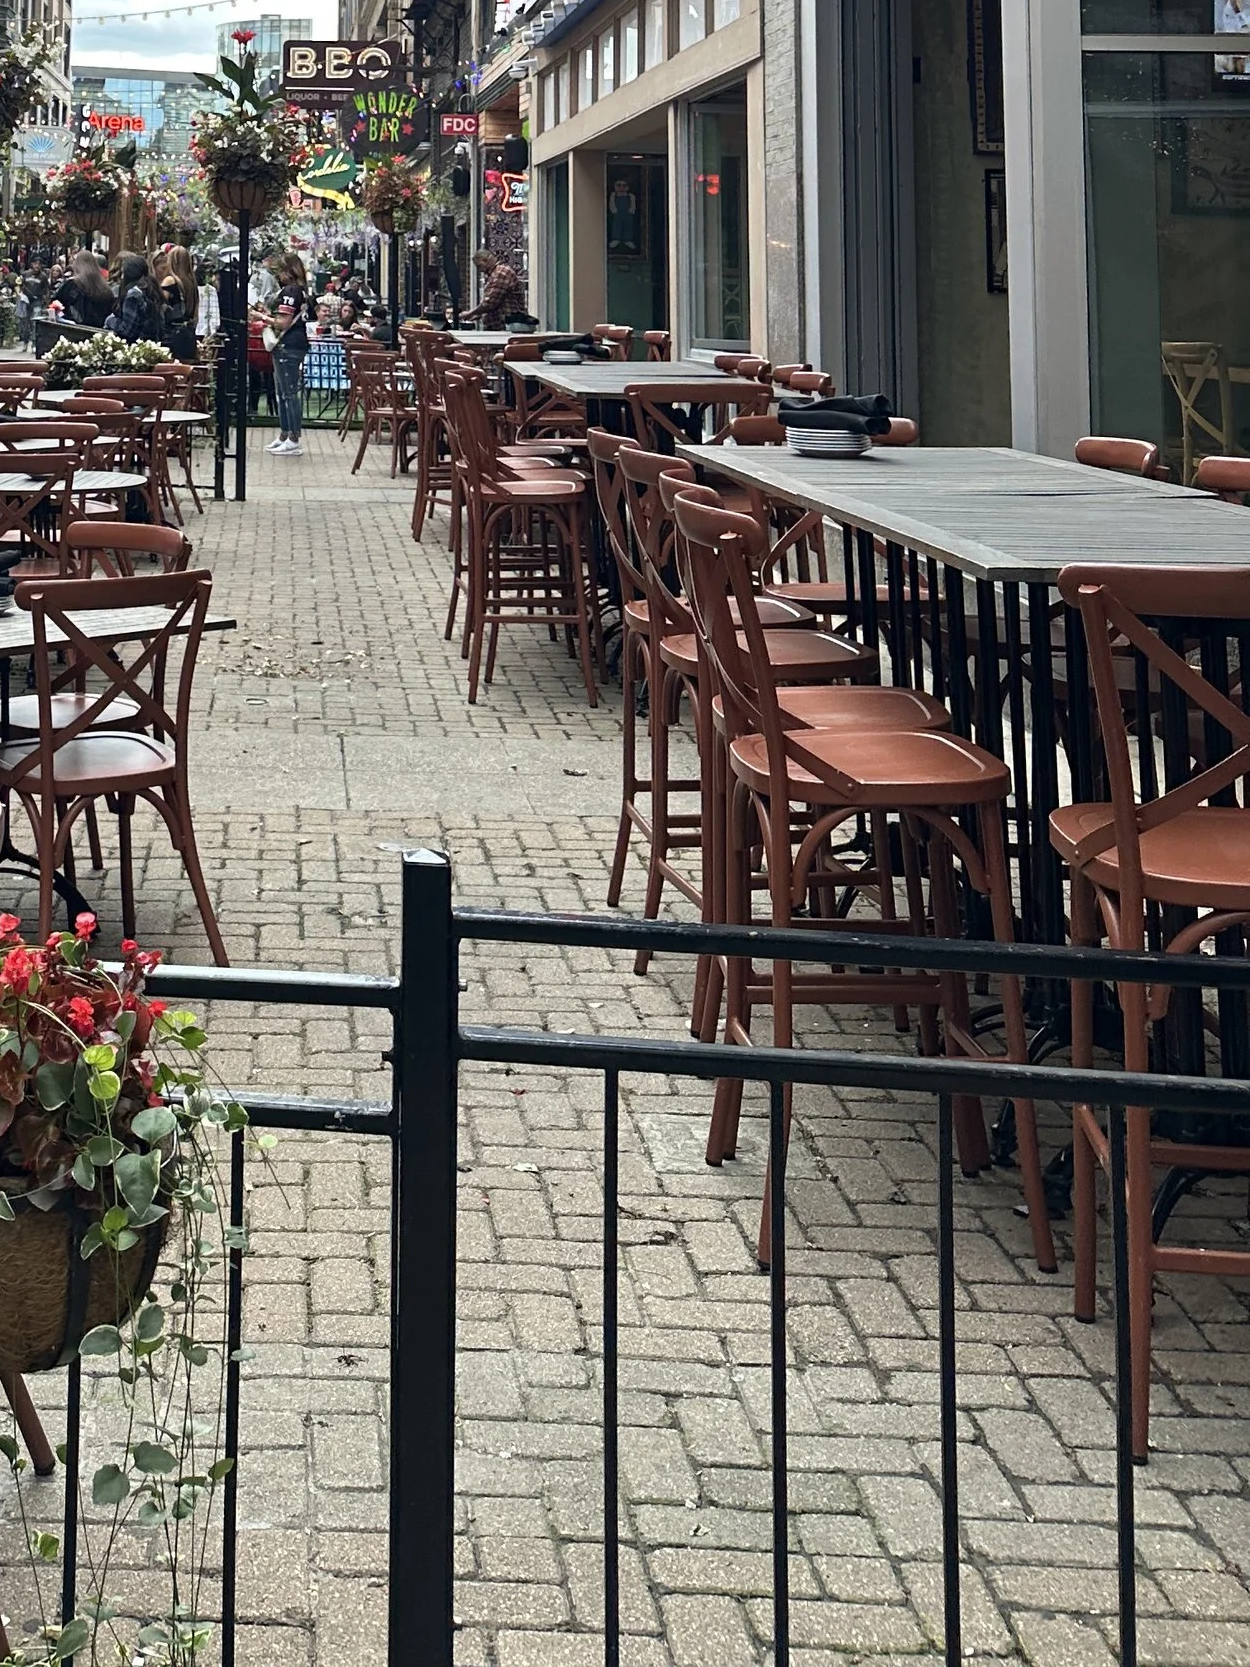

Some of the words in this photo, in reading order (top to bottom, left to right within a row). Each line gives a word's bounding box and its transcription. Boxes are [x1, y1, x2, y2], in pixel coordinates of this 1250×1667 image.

[286, 92, 320, 102] LIQUOR
[353, 90, 418, 120] WONDER
[88, 110, 146, 132] Arena
[368, 117, 400, 143] BAR
[442, 117, 476, 132] FDC
